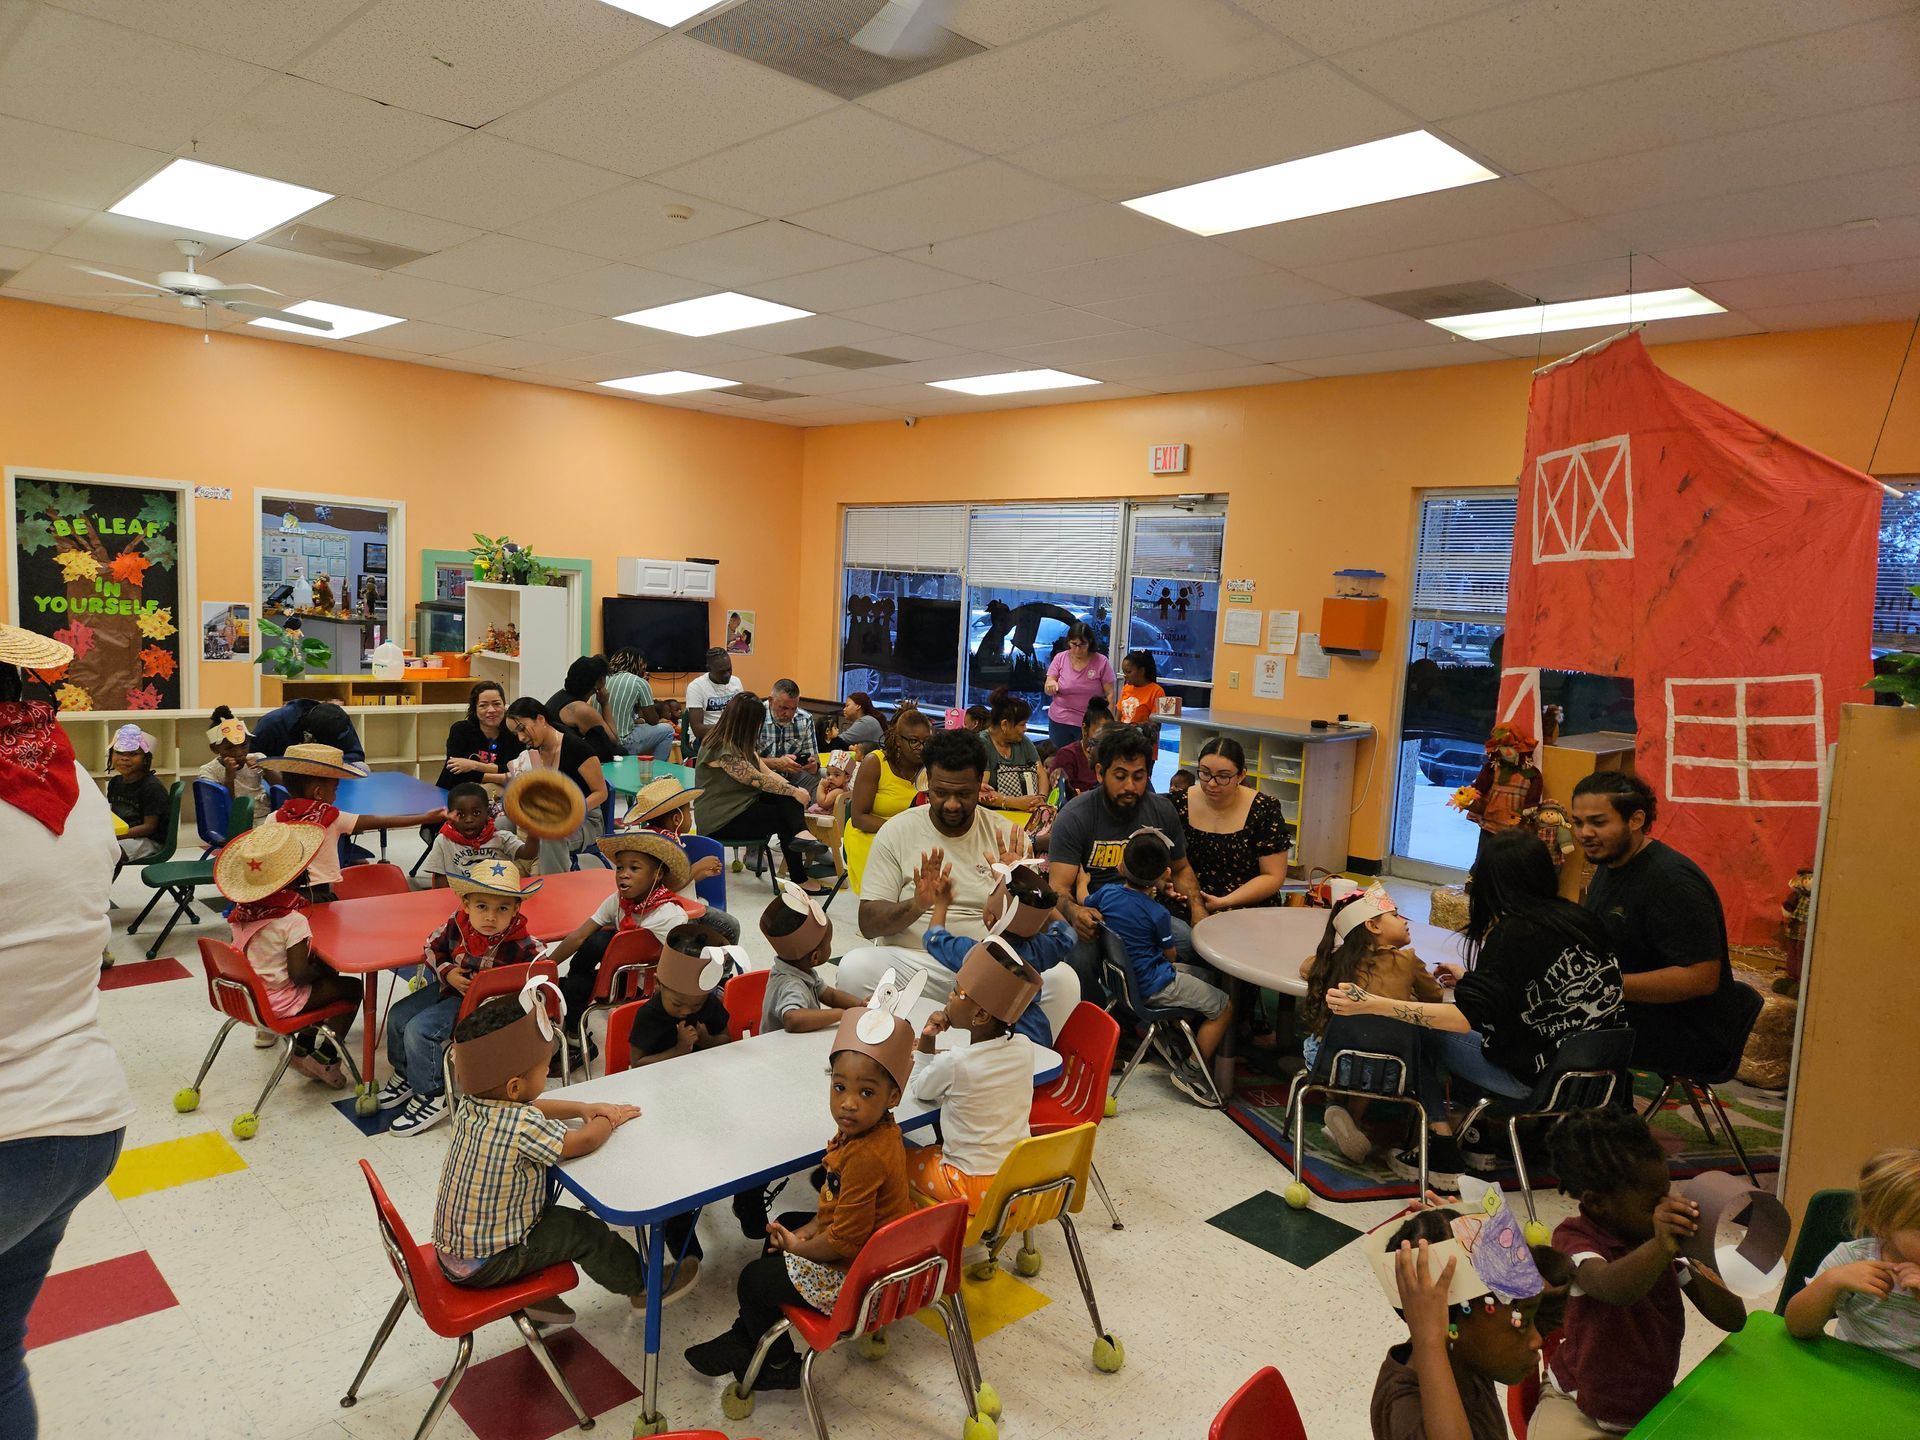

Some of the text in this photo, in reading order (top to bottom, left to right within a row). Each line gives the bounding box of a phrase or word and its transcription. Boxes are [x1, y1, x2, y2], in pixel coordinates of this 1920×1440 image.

[1154, 446, 1180, 470] EXIT
[53, 519, 89, 537] BE
[95, 576, 121, 598] IN
[33, 595, 159, 616] YOURSELF
